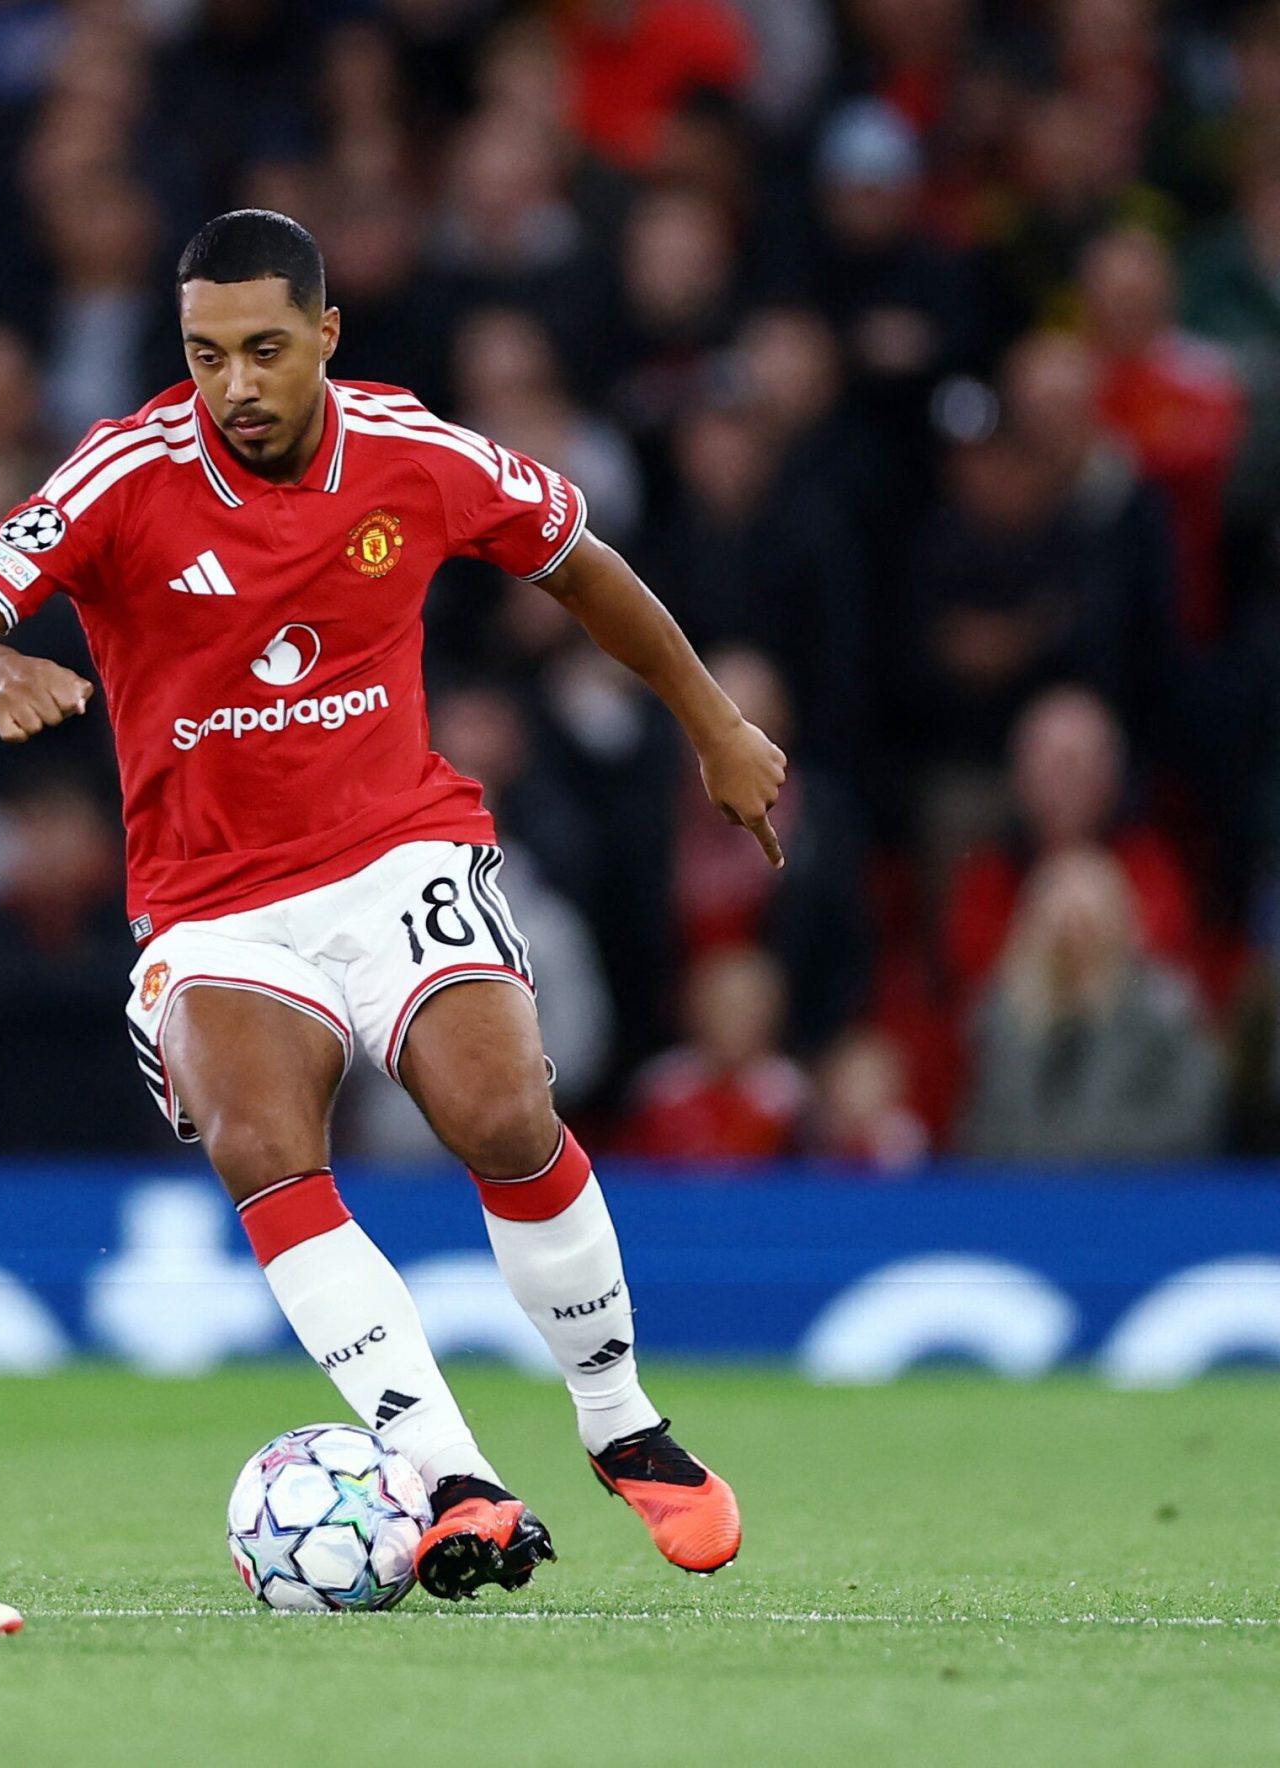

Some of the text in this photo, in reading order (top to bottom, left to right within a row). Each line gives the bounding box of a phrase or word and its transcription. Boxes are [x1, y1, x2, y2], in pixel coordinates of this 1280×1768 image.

[360, 558, 394, 573] UNITED
[401, 876, 475, 965] 18
[551, 1279, 622, 1320] MUFC
[319, 1325, 387, 1374] MUFC
